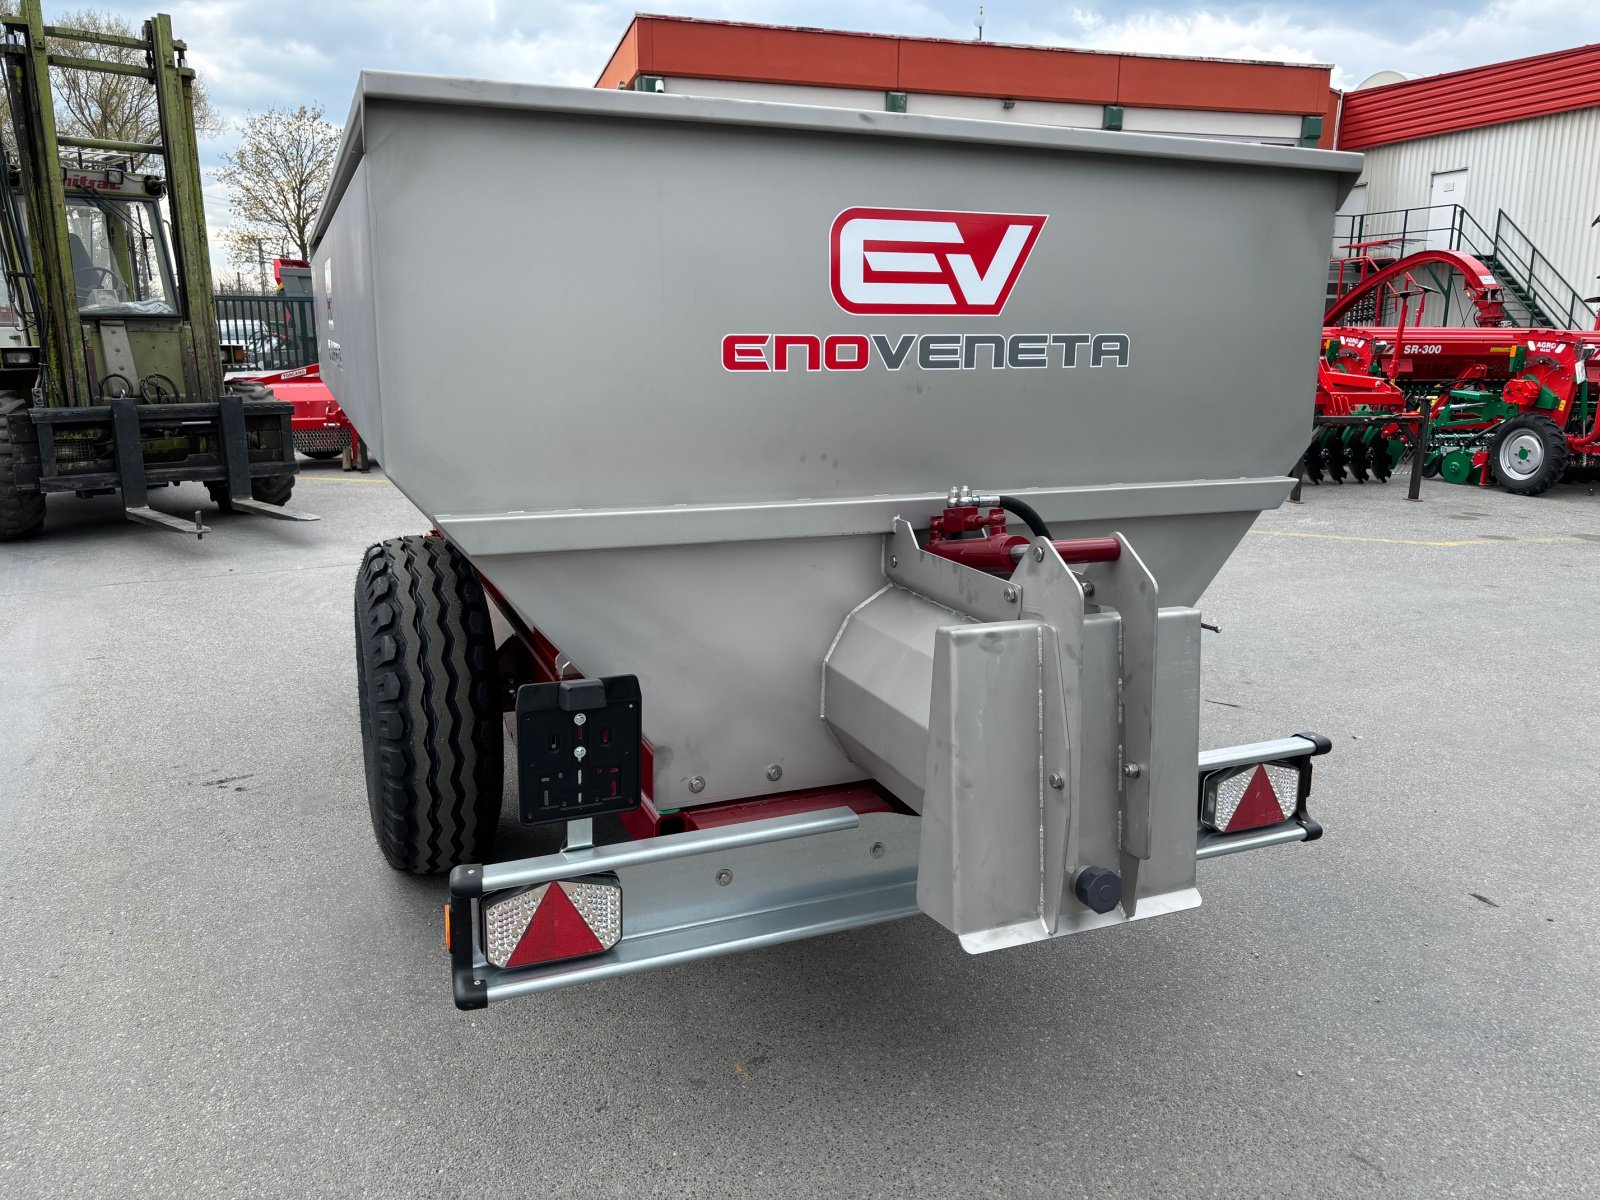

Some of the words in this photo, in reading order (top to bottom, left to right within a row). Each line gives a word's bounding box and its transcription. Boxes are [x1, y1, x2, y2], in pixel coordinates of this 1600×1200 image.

[839, 217, 1034, 306] EV
[1403, 344, 1442, 355] SR-300
[1536, 341, 1557, 350] AGRO
[721, 333, 1131, 372] ENOVENETA
[282, 369, 306, 379] TOSCANO
